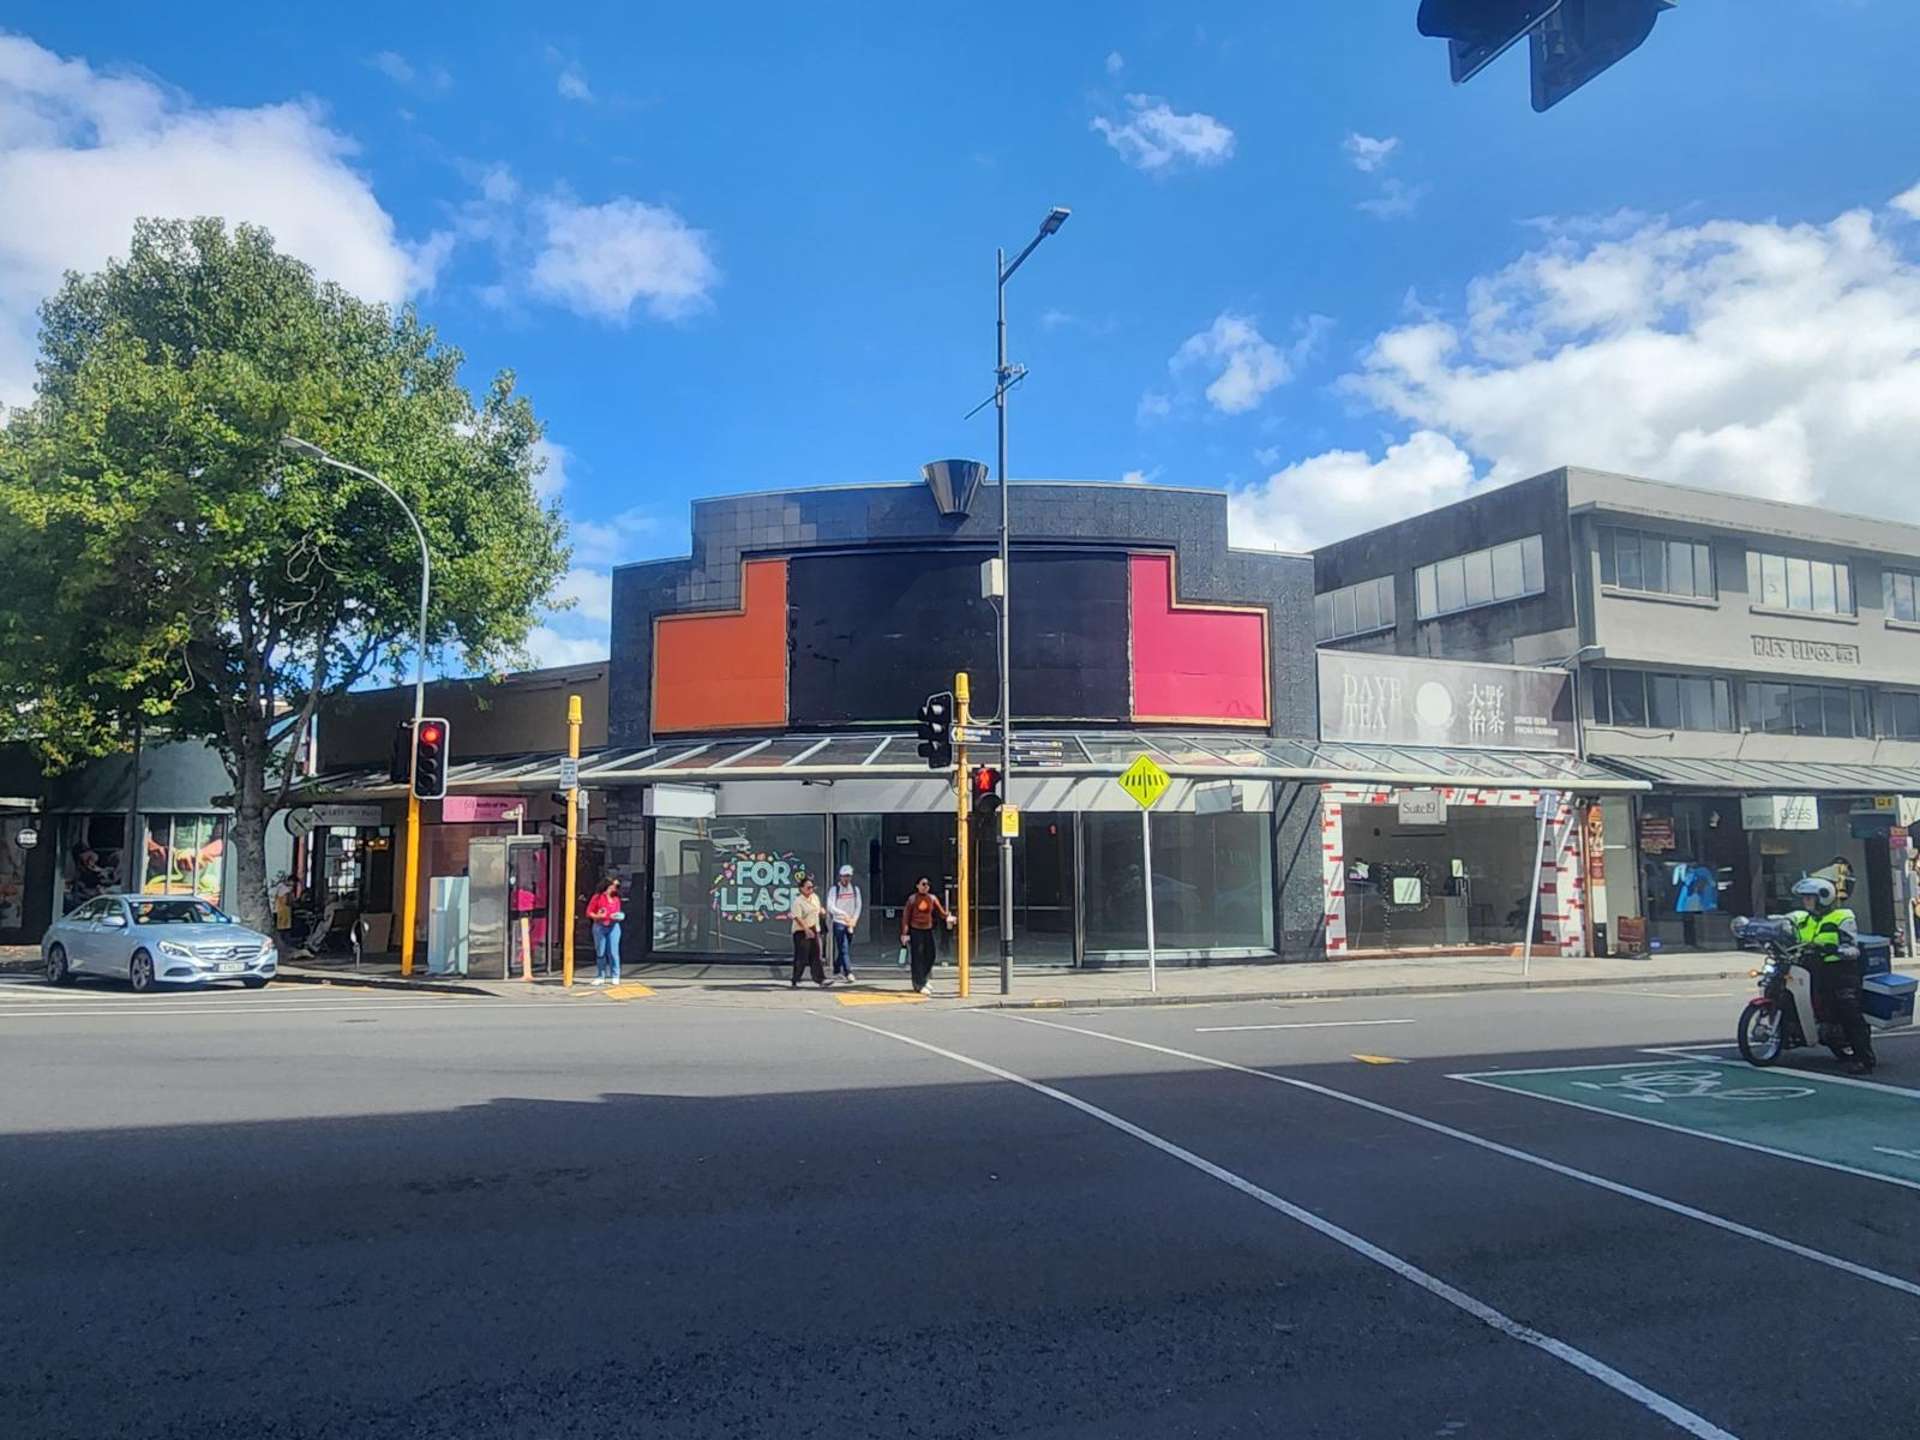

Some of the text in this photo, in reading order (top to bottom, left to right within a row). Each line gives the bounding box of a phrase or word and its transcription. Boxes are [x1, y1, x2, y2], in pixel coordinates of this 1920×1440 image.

[1343, 673, 1402, 701] DAYE
[1343, 703, 1387, 728] TEA
[736, 860, 791, 886] FOR
